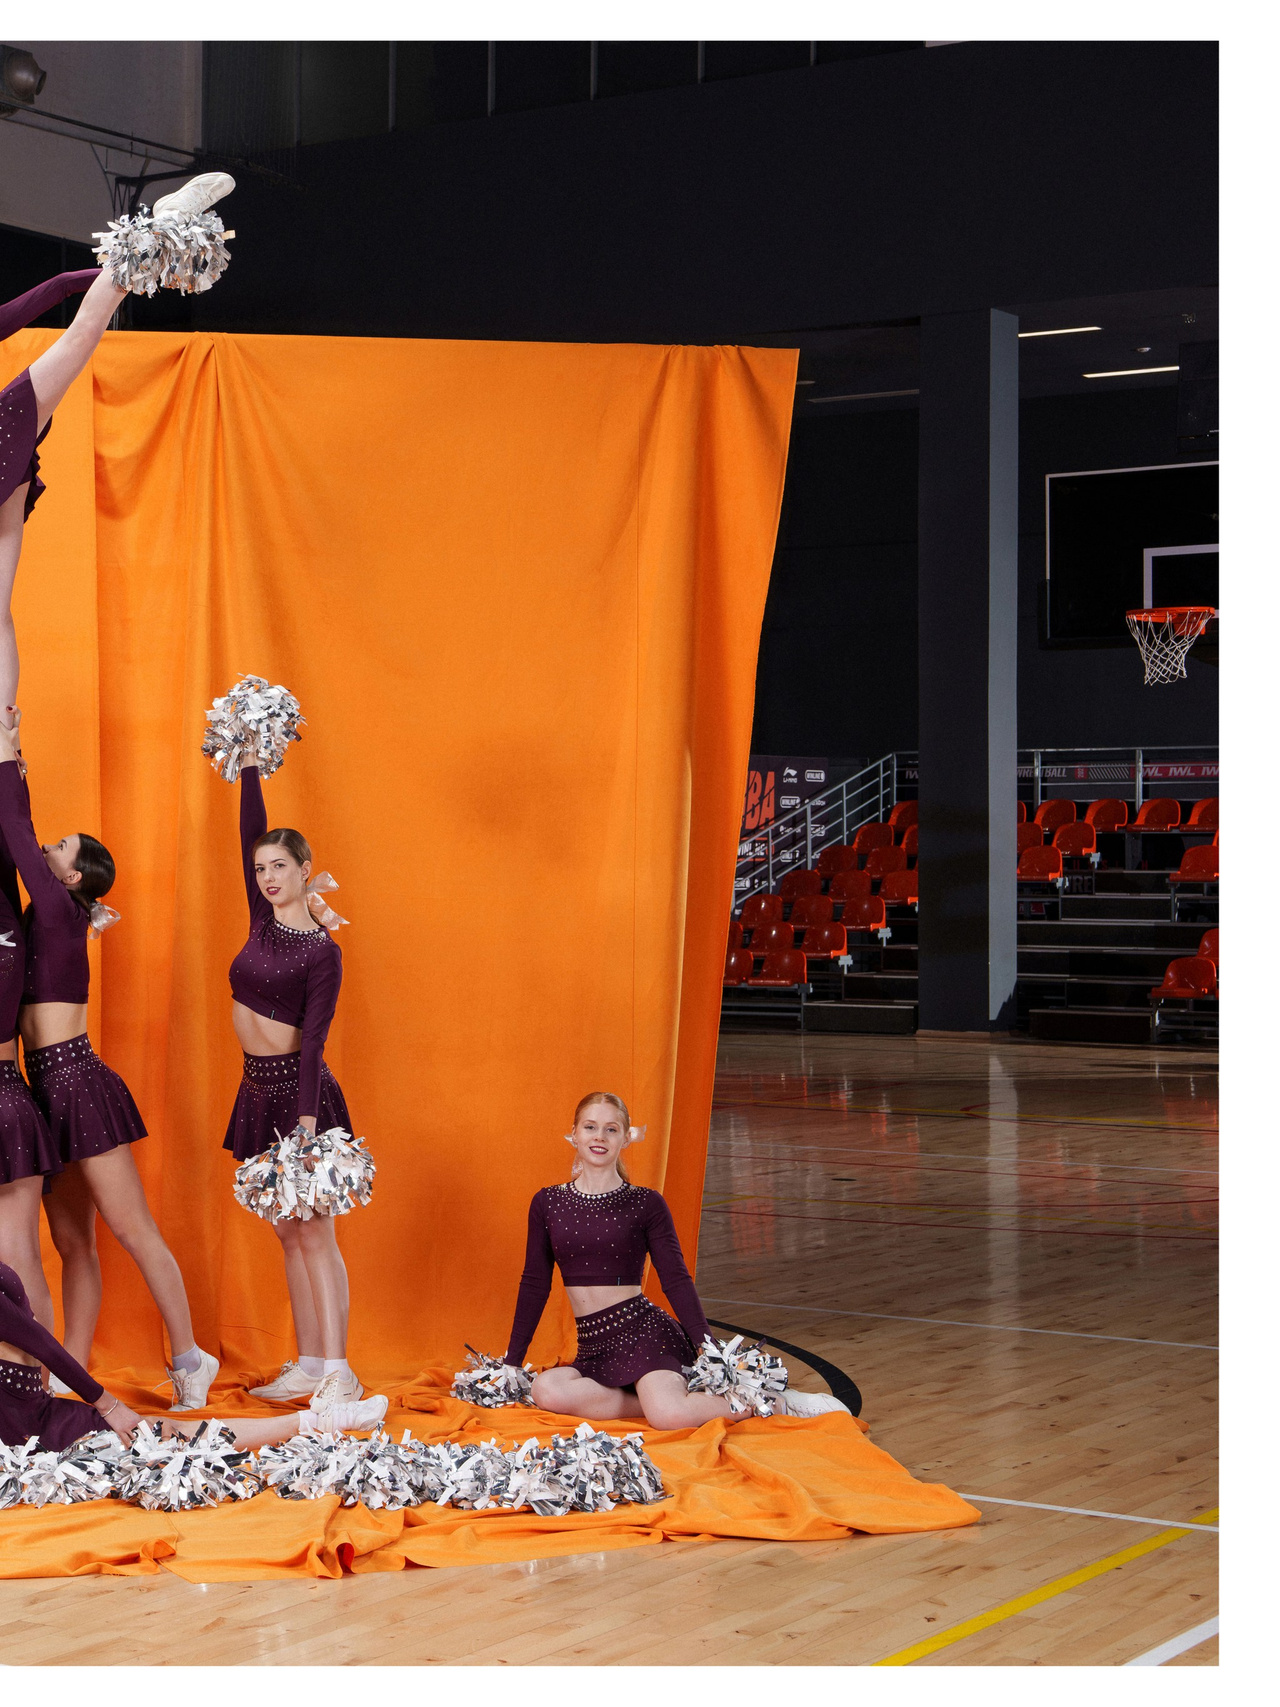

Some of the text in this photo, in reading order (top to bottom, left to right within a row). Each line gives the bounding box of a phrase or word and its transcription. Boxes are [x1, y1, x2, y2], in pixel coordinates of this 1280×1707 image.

[1141, 765, 1219, 777] WL IWL IW
[742, 771, 775, 829] BA
